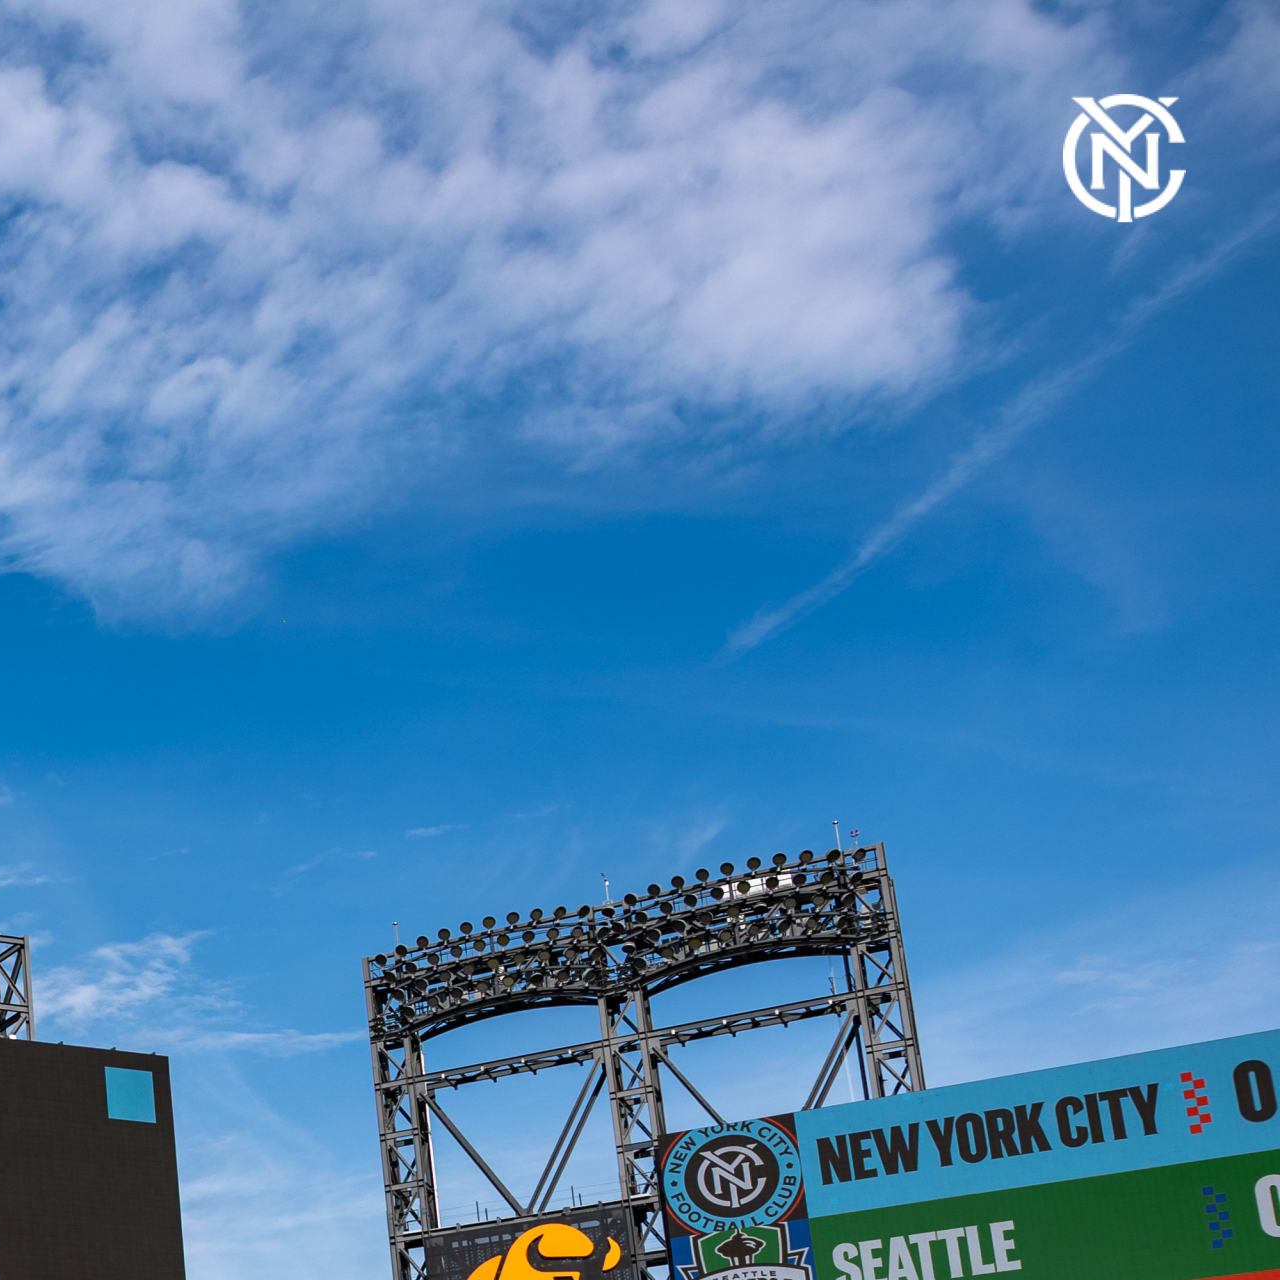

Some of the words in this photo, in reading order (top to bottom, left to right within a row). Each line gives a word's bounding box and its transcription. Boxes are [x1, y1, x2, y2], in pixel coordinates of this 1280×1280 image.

[1232, 1059, 1278, 1123] 0
[669, 1137, 697, 1174] NEW
[698, 1121, 755, 1138] YORK
[758, 1126, 793, 1157] CITY
[816, 1122, 920, 1185] NEW
[925, 1102, 1051, 1167] YORK
[1055, 1082, 1160, 1147] CITY
[671, 1191, 764, 1232] FOOTBALL
[765, 1175, 797, 1217] CLUB
